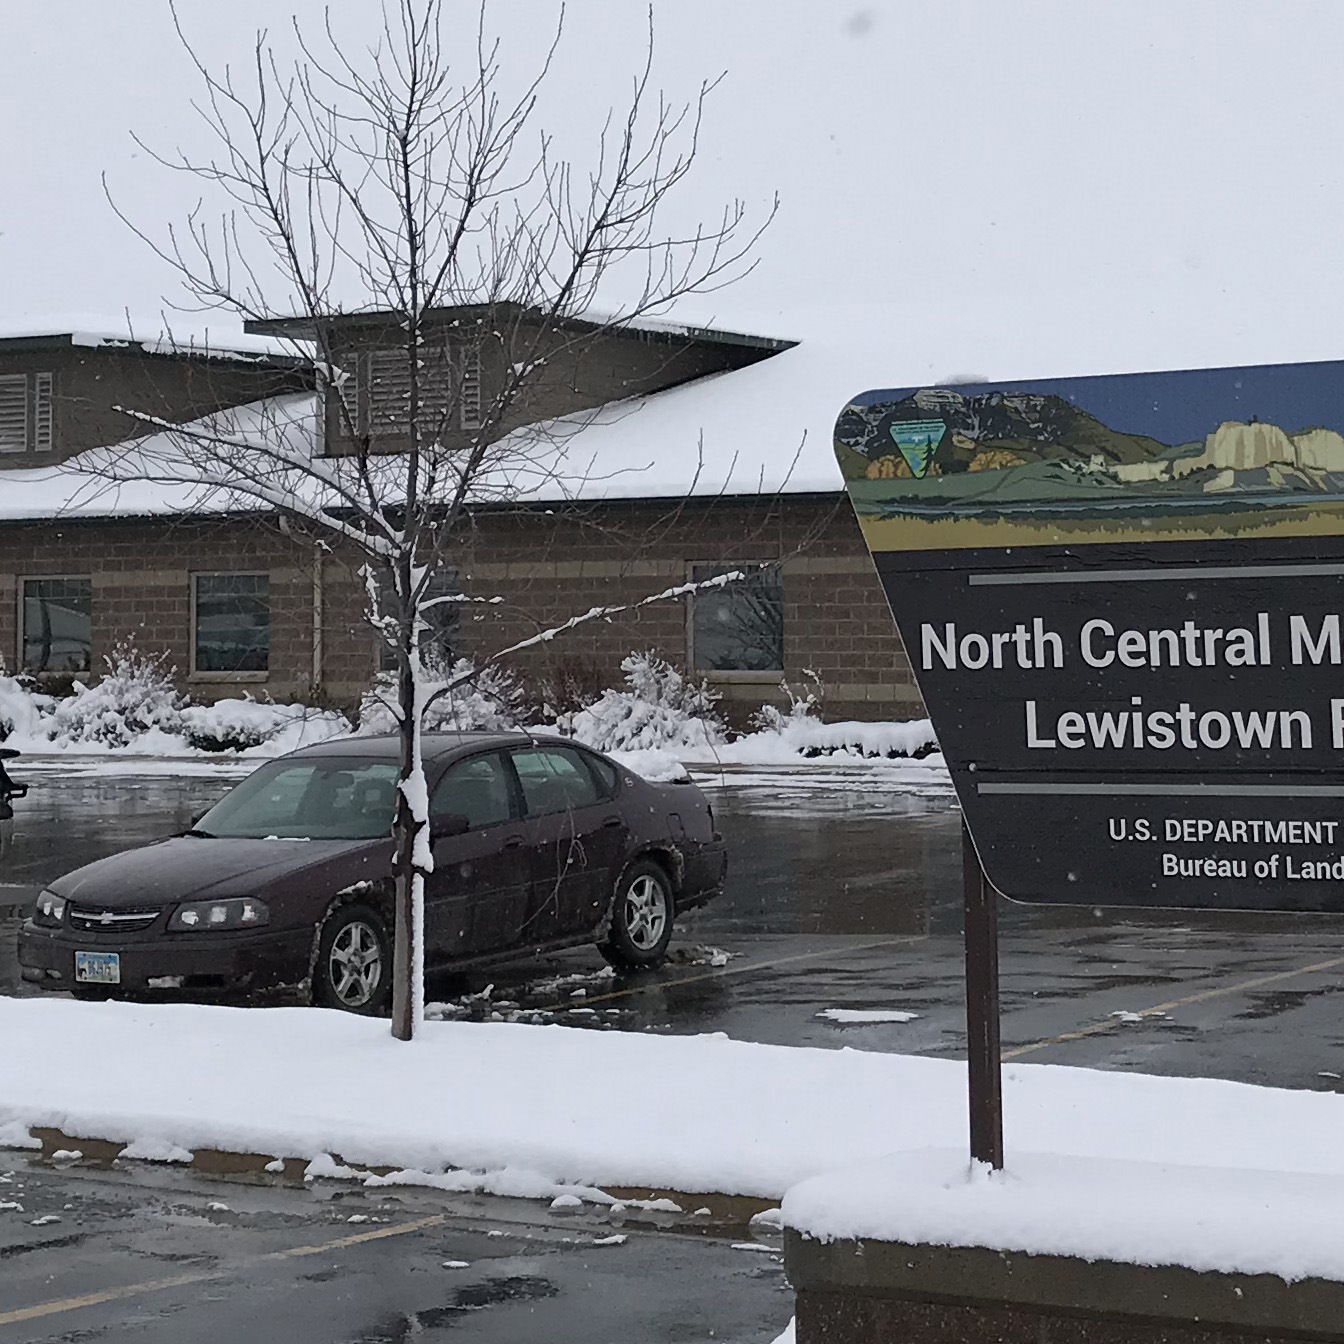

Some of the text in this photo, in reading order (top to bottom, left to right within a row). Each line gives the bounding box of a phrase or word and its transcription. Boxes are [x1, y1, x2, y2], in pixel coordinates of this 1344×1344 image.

[921, 618, 1064, 670] North
[1080, 612, 1271, 668] Central
[1025, 696, 1313, 749] Lewistown
[1109, 818, 1156, 841] U.S.
[1165, 819, 1339, 844] DEPARTMENT
[1162, 853, 1247, 878] Bureau
[1254, 854, 1280, 878] of
